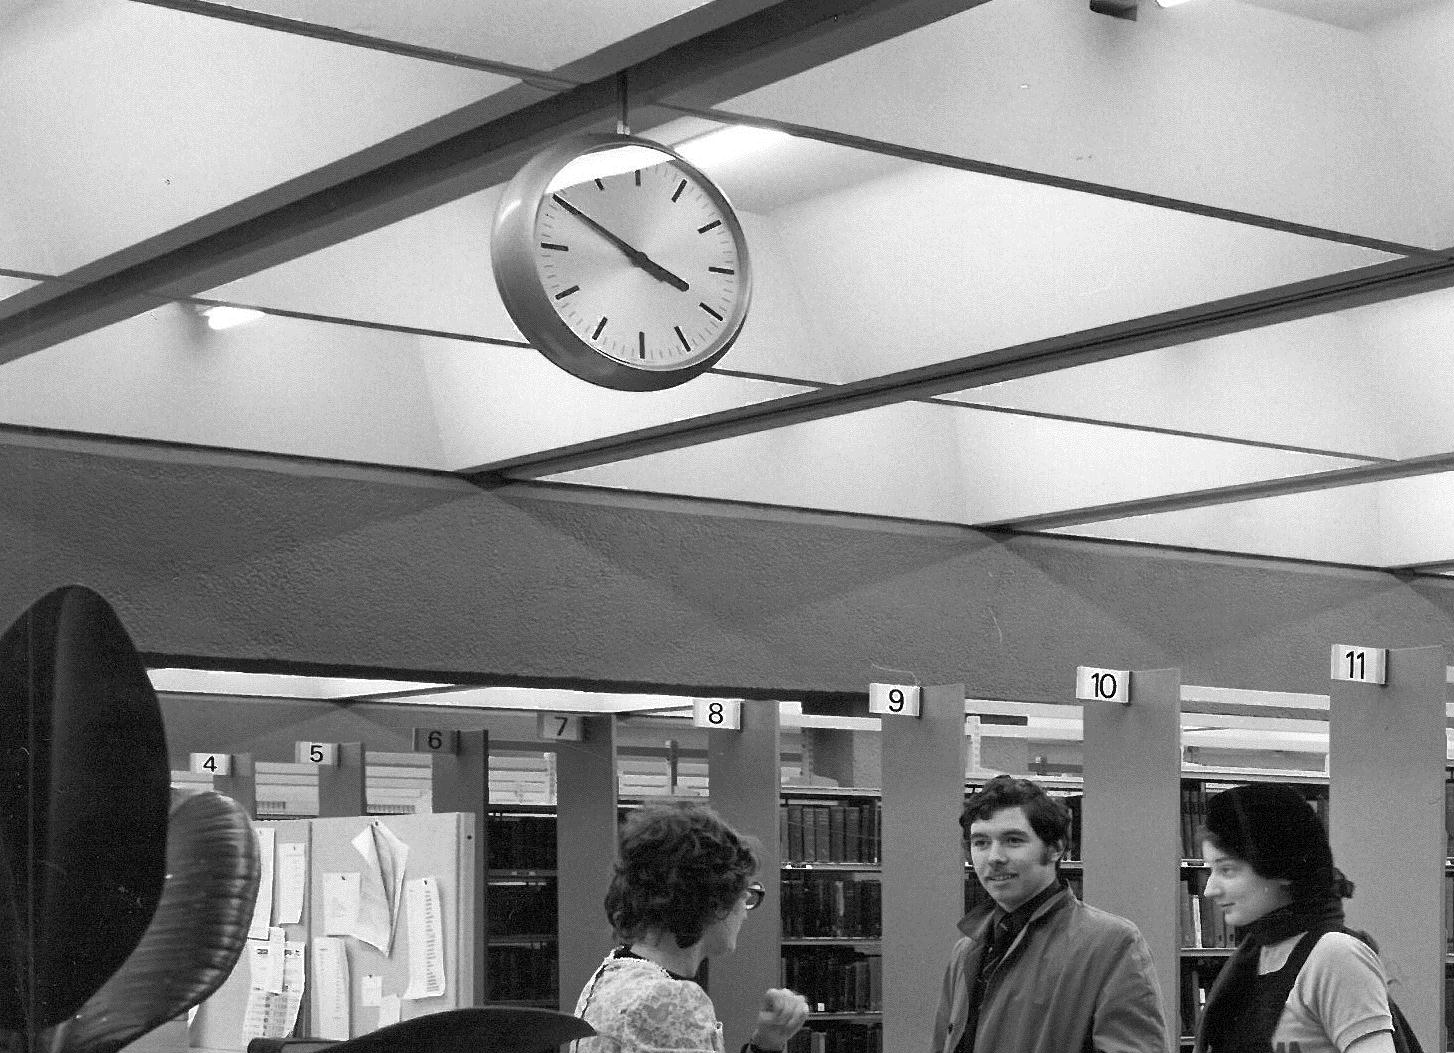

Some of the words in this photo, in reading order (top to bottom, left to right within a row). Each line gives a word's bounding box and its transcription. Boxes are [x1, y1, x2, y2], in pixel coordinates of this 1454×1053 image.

[1345, 650, 1365, 680] 11
[1091, 672, 1117, 699] 10
[888, 688, 905, 713] 9
[708, 702, 724, 725] 8
[554, 716, 569, 737] 7
[427, 730, 443, 750] 6
[202, 755, 218, 773] 4
[309, 744, 324, 763] 5
